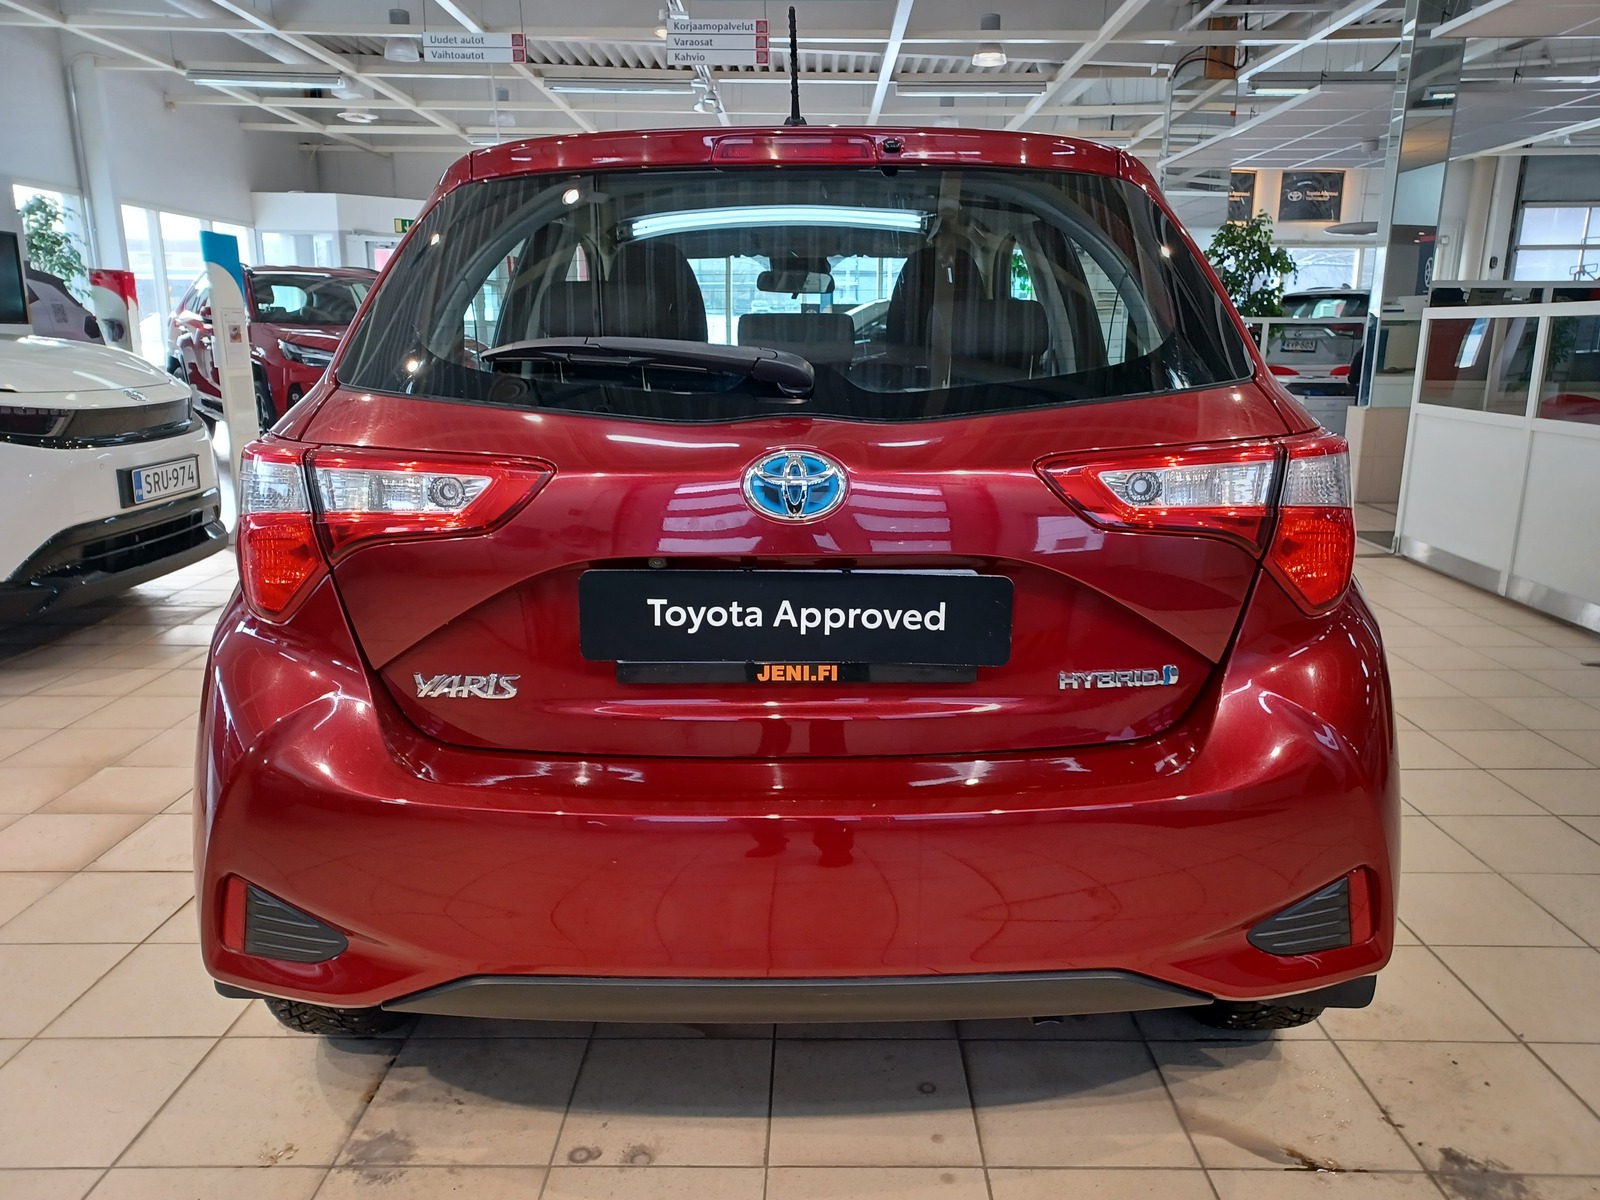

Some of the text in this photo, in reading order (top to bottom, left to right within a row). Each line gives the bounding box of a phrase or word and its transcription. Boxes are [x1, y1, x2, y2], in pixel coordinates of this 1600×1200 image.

[673, 22, 754, 32] Korjaamopalvelut
[430, 35, 485, 45] Uudet autot
[674, 38, 713, 46] Varaosat
[431, 50, 485, 60] Vaihtoautot
[674, 52, 706, 61] Kahvio
[144, 464, 195, 494] SRU-974
[646, 598, 946, 635] Toyota Approved
[757, 664, 838, 682] JENI.FI
[1059, 669, 1159, 690] HYBRID
[413, 670, 521, 700] YARIS
